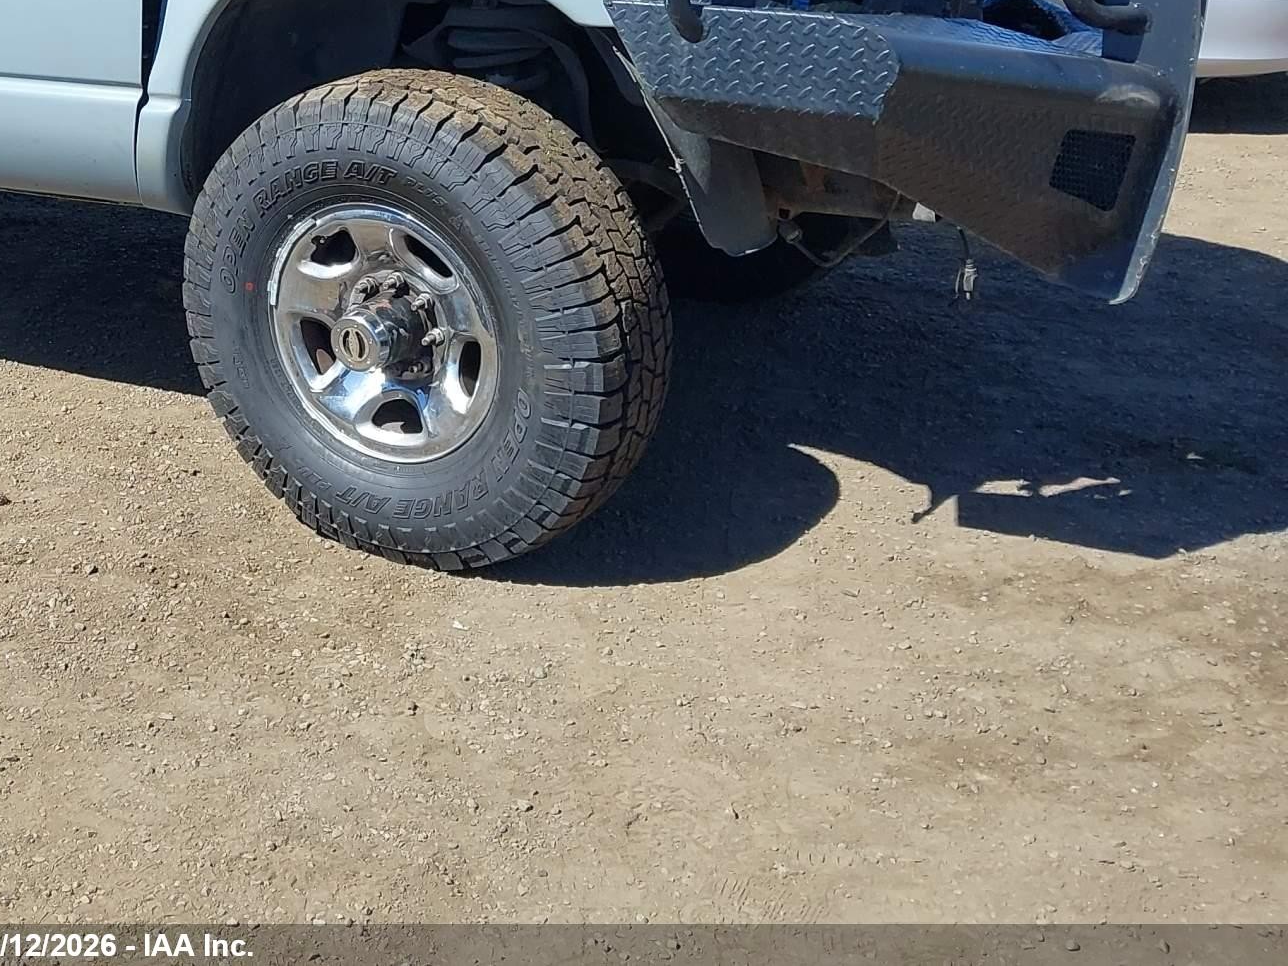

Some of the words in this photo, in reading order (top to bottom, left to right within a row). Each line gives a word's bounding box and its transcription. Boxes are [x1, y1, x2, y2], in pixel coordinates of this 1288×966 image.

[220, 209, 256, 294] OPEN
[253, 158, 339, 218] RANGE
[344, 160, 397, 184] A/T
[490, 387, 531, 483] OPEN
[295, 458, 333, 491] PLU
[335, 485, 392, 514] A/T
[392, 467, 489, 519] RANGE
